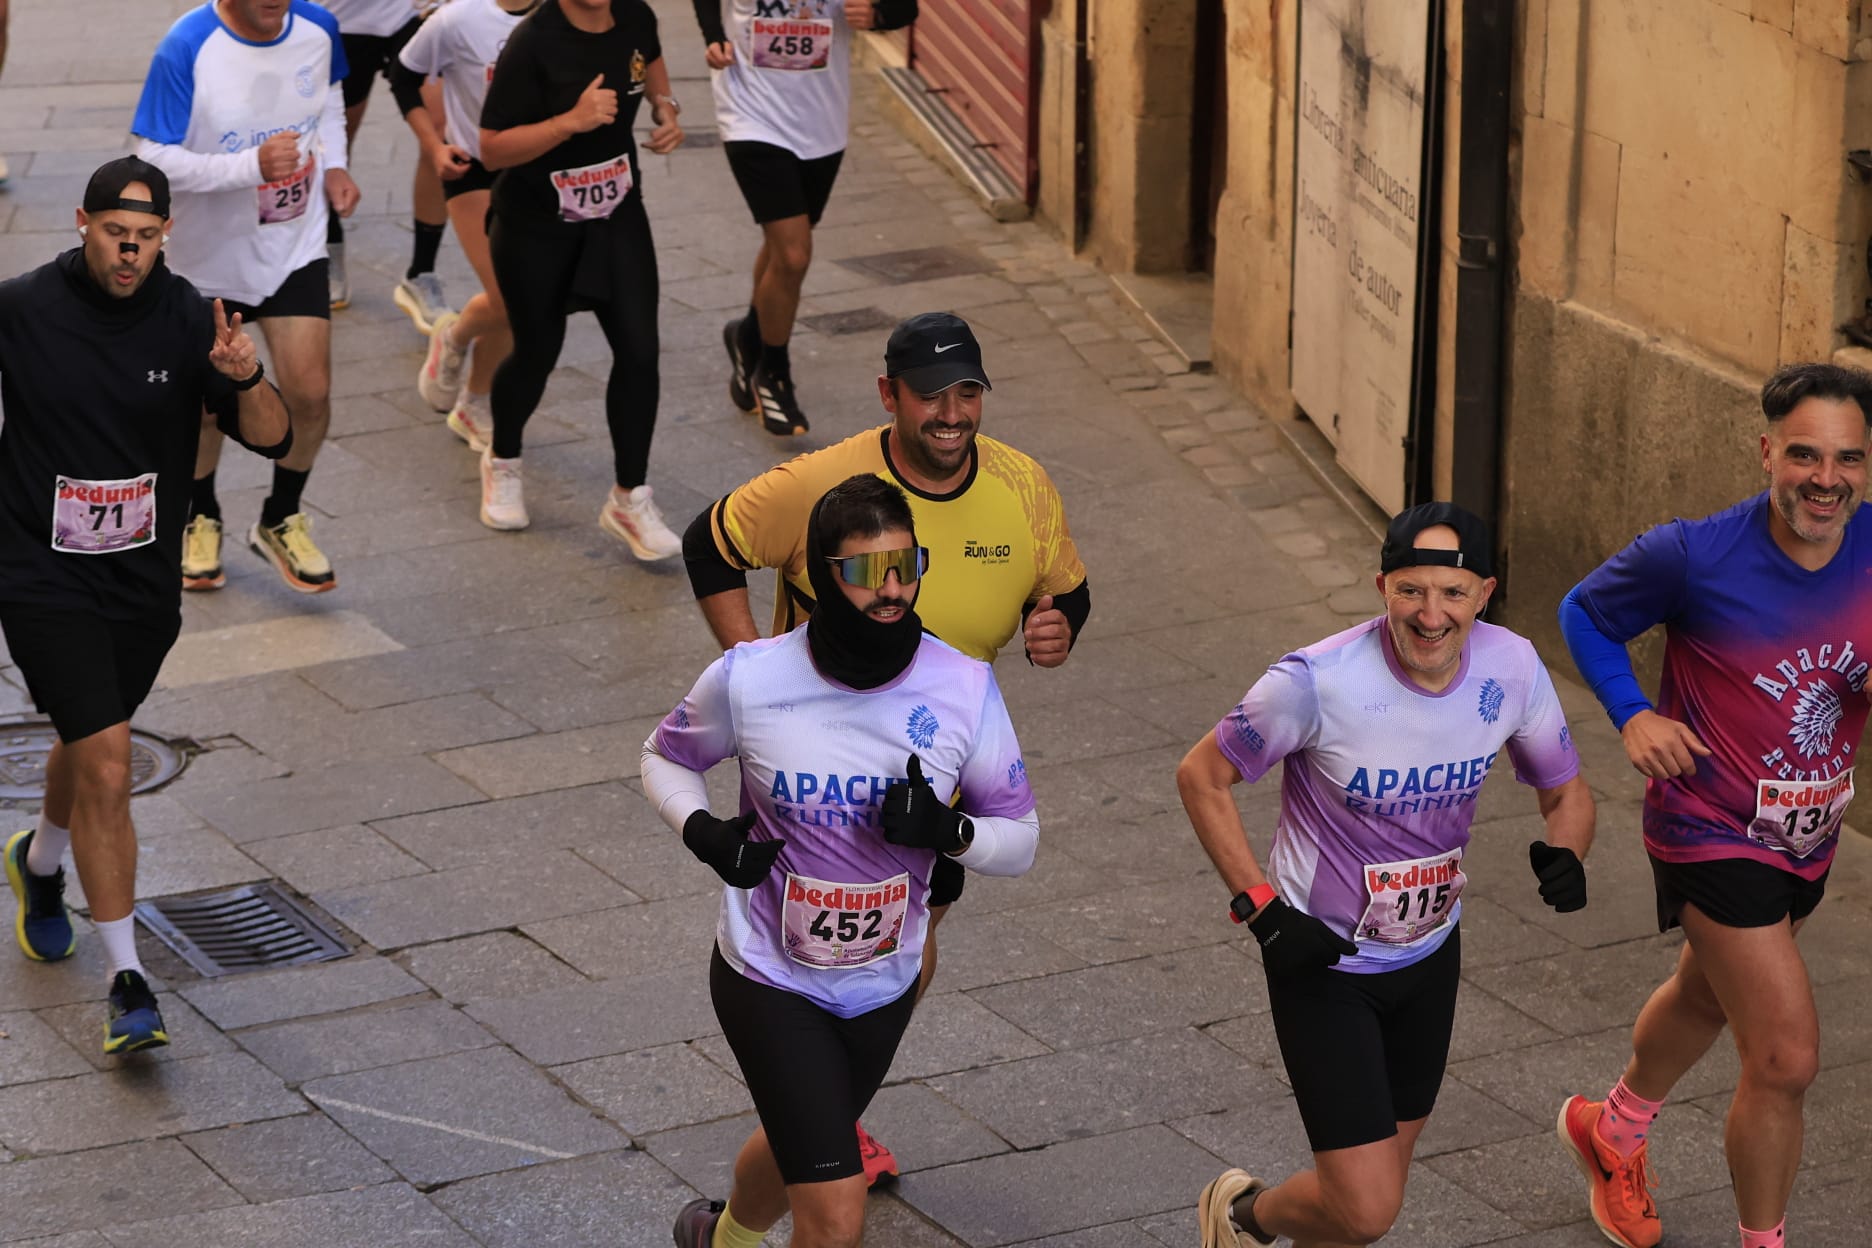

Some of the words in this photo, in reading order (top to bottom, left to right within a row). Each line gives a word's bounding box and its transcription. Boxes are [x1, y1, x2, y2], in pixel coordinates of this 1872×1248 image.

[754, 20, 831, 36] bedunia
[768, 35, 814, 56] 458
[554, 158, 628, 189] bedunia
[572, 180, 619, 209] 703
[1350, 240, 1365, 284] de
[1366, 265, 1403, 318] autor
[88, 503, 124, 532] 71
[770, 770, 934, 807] APACH
[1345, 790, 1478, 817] RUNNIN
[787, 879, 907, 910] bedunia
[1394, 883, 1451, 922] 115
[809, 909, 883, 943] 452
